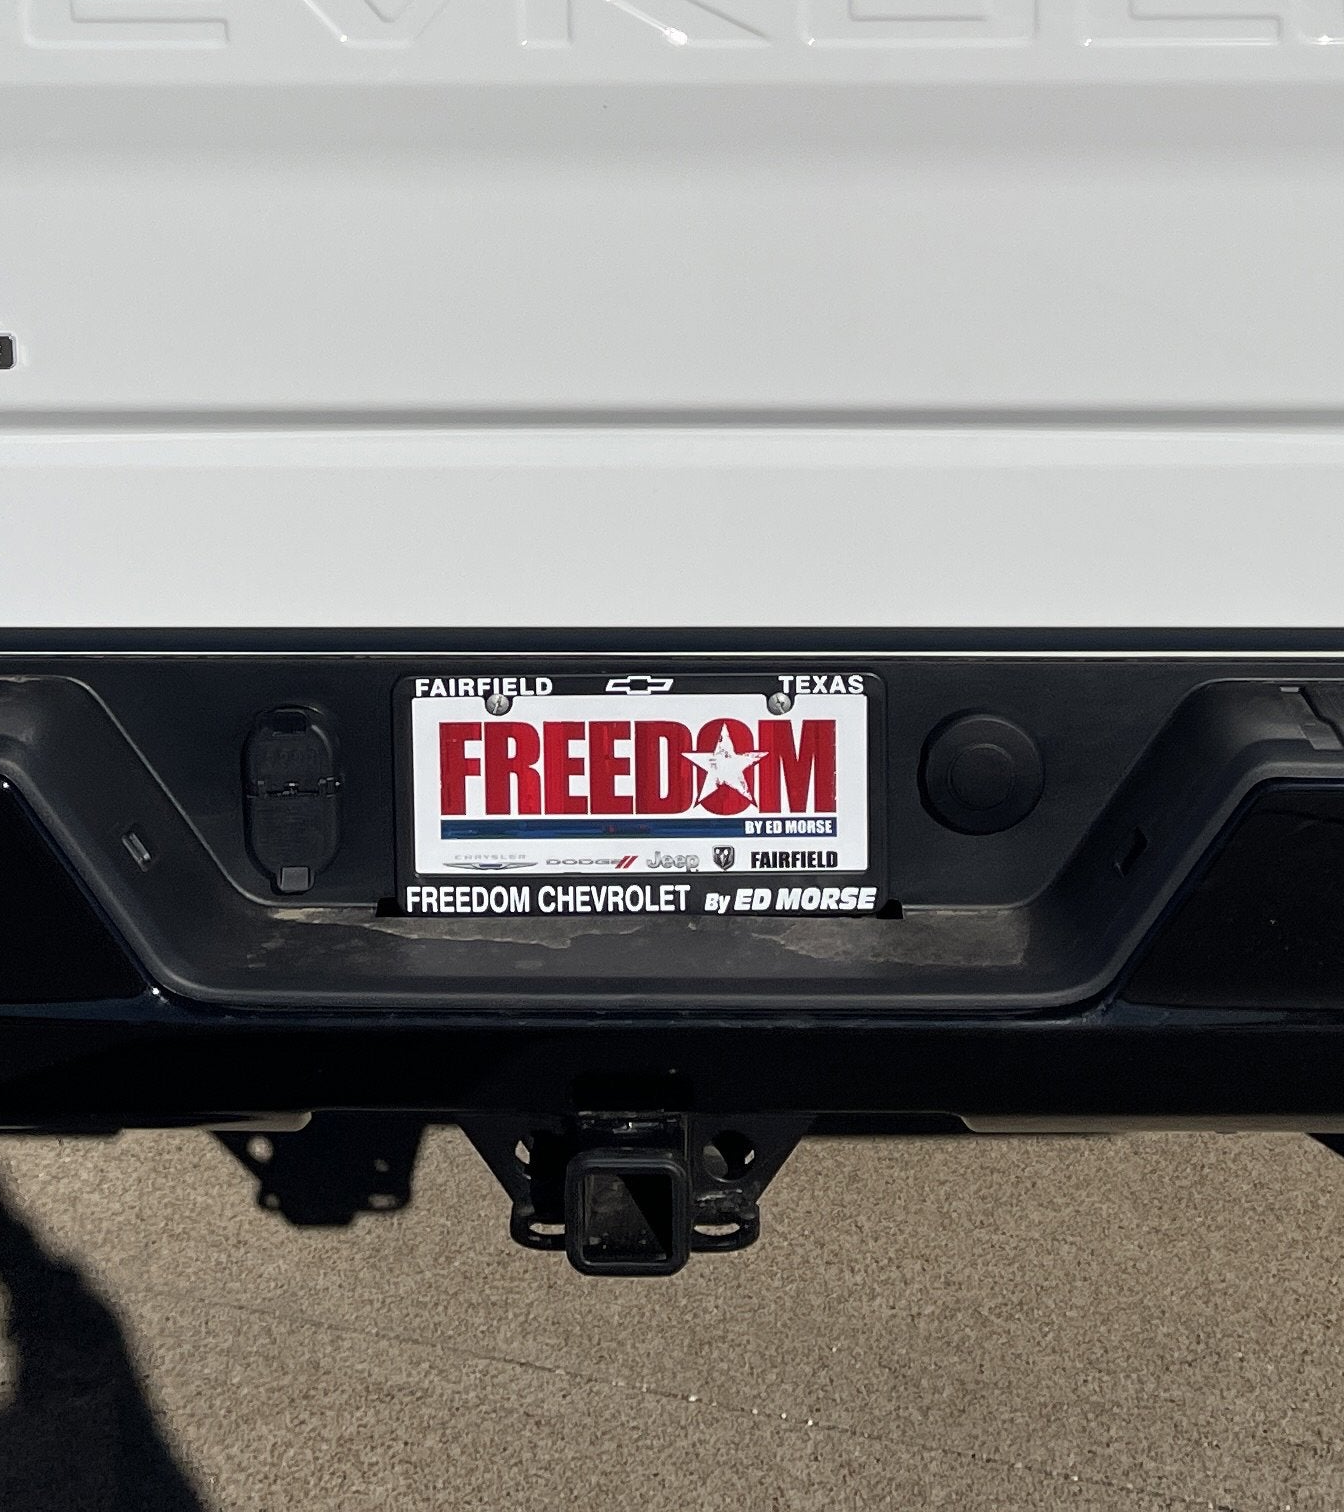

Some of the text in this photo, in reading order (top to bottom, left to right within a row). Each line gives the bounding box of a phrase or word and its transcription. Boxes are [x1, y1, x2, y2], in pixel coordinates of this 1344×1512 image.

[415, 678, 553, 696] FAIRFIELD
[778, 675, 864, 694] TEXAS
[439, 719, 837, 816] FREEDOM
[745, 820, 833, 834] BY ED MORSE
[646, 851, 700, 871] Jeep
[751, 851, 839, 869] FAIRFIELD
[406, 885, 691, 914] FREEDOM CHEVROLET
[705, 888, 878, 914] By ED MORSE
